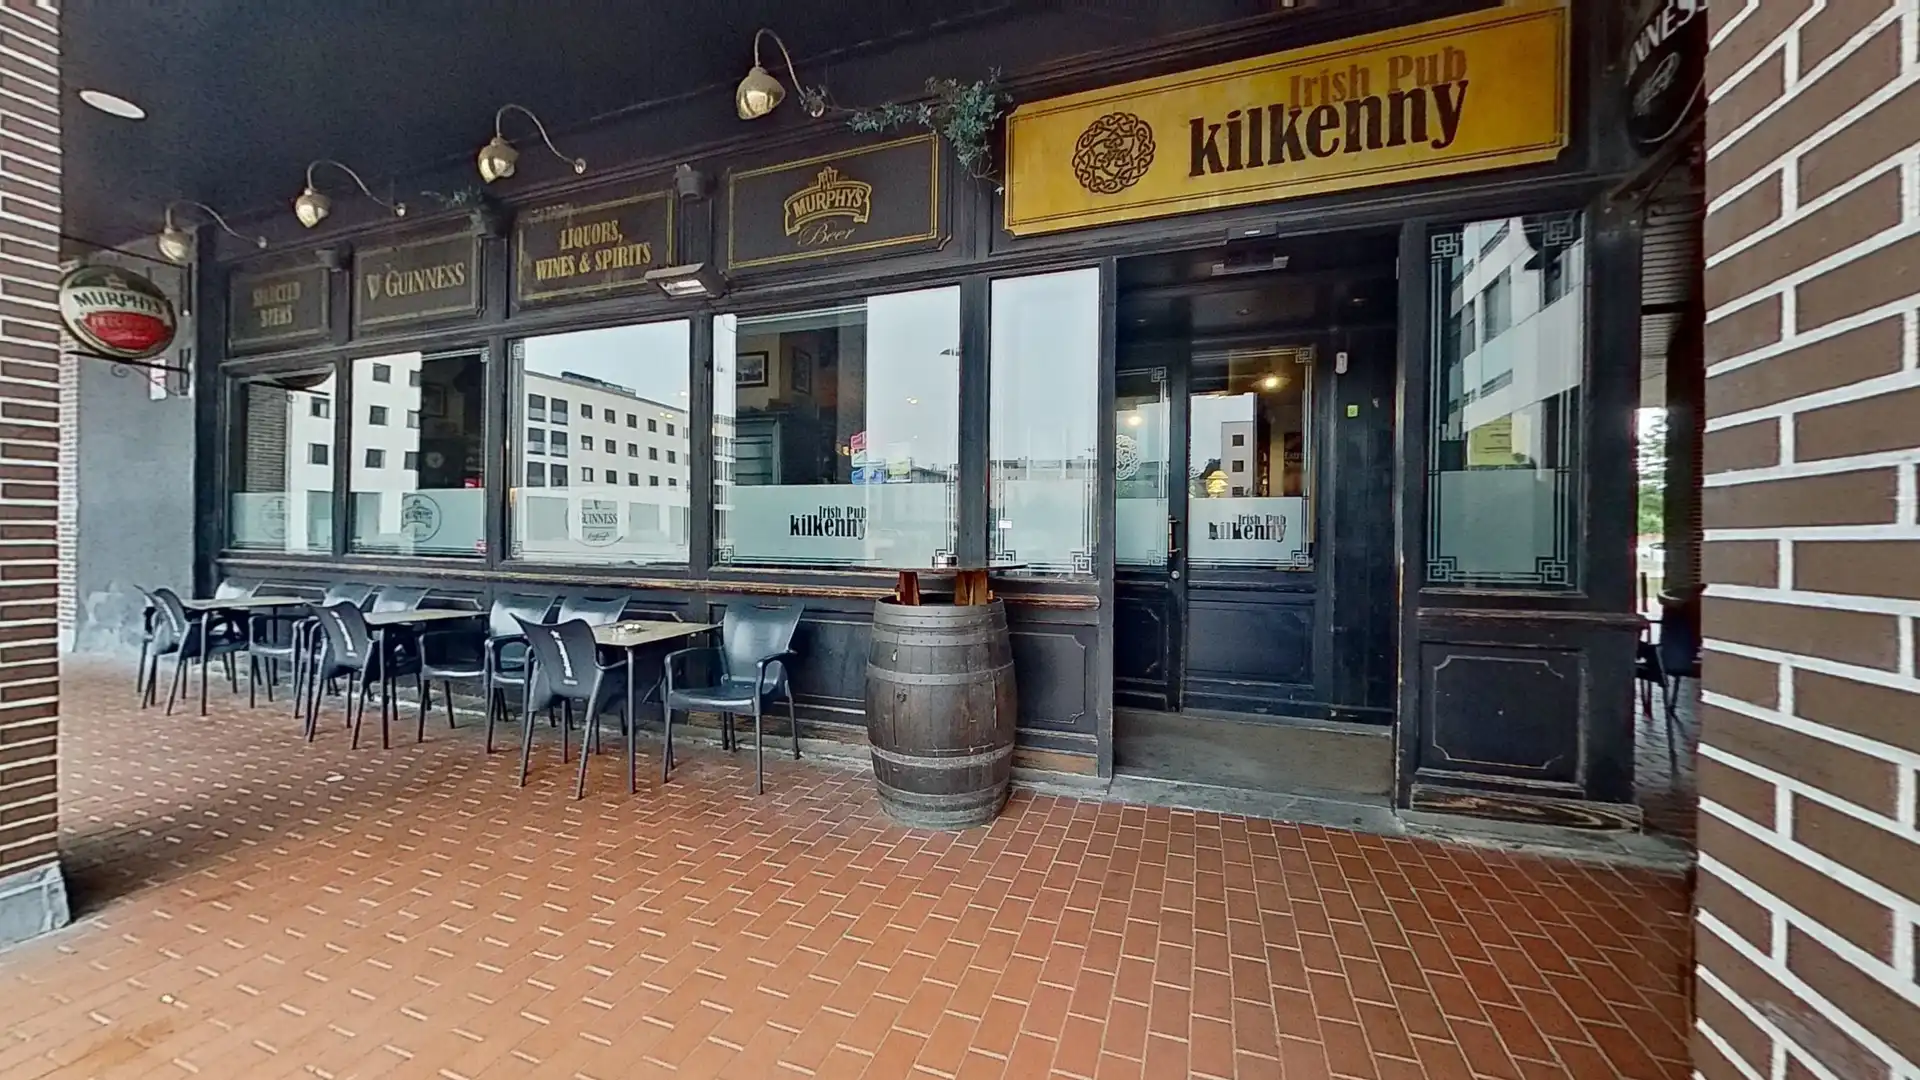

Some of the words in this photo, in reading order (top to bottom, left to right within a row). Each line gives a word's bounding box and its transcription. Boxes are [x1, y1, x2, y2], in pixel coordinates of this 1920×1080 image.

[1288, 64, 1370, 109] Irish
[1388, 45, 1468, 91] Pub
[1189, 80, 1469, 177] kilkenny
[792, 186, 864, 218] MURPHYS
[560, 219, 623, 250] LIQUORS,
[797, 220, 856, 246] Beer
[536, 254, 576, 281] WINES
[579, 252, 590, 273] &
[595, 242, 651, 271] SPIRITS
[385, 262, 465, 297] GUINNESS
[790, 514, 867, 540] kilkenny
[819, 505, 841, 519] Irish
[846, 506, 867, 519] Pub
[1238, 514, 1261, 525] Irish
[1265, 514, 1287, 526] Pub
[1208, 521, 1287, 543] kilkenny
